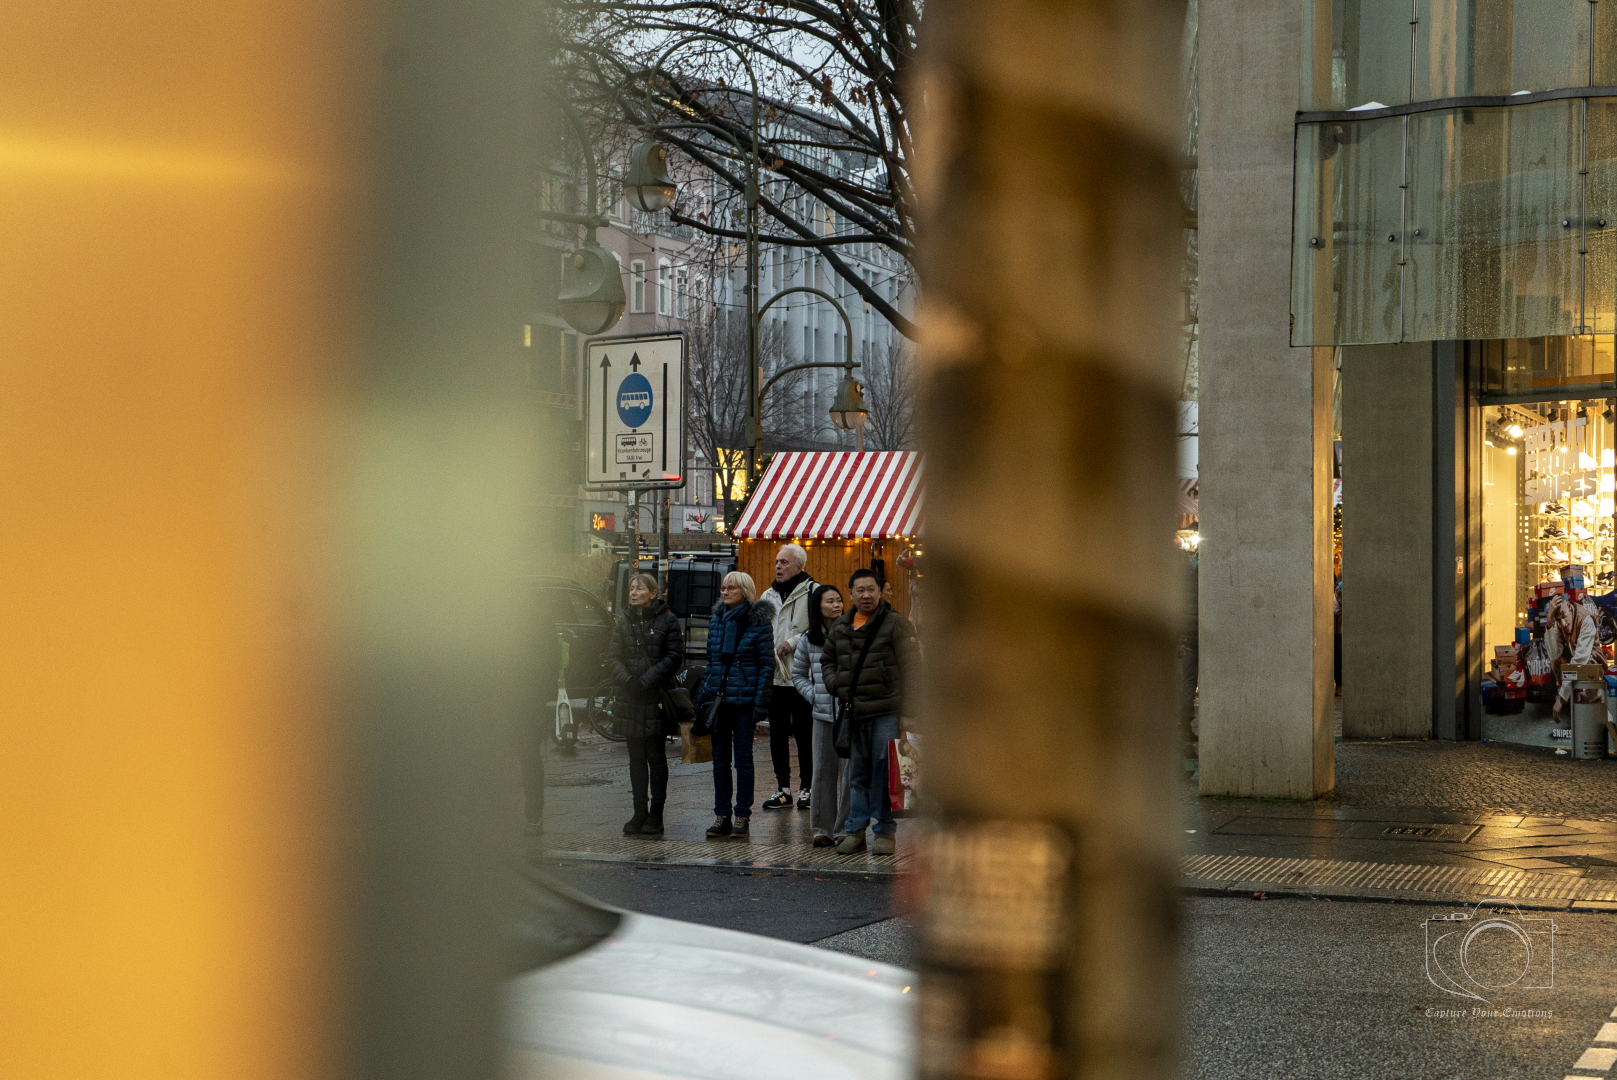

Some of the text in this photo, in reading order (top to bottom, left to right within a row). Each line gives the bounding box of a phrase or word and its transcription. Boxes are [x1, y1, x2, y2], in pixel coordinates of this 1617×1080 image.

[1525, 417, 1587, 452] GOT IT
[1525, 446, 1580, 481] FROM
[1525, 469, 1597, 506] SNIPES
